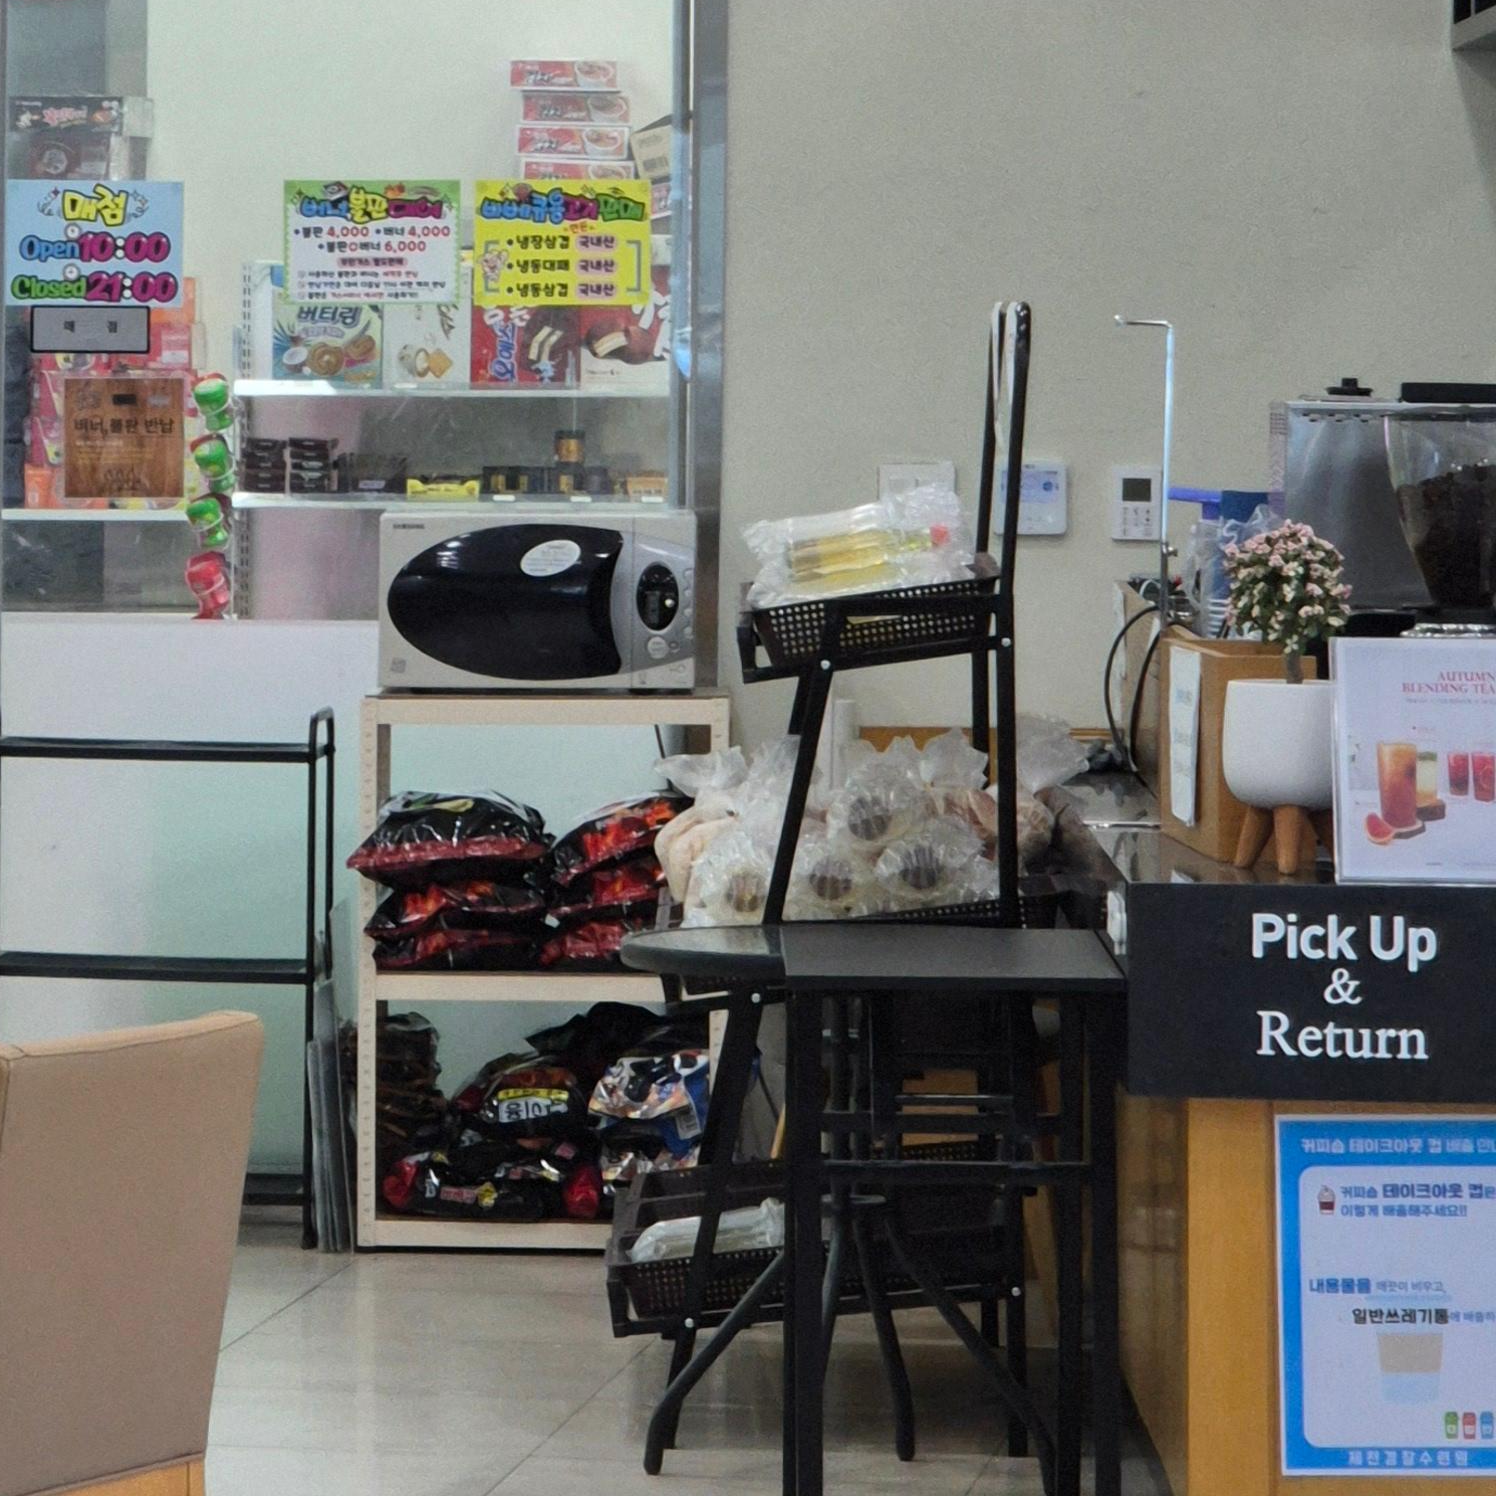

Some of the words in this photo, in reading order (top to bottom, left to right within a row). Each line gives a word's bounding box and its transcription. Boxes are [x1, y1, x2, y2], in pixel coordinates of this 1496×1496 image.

[327, 226, 369, 239] 4,000
[407, 226, 450, 239] 4,000
[19, 235, 80, 262] Open
[78, 231, 171, 262] 10:00
[384, 241, 426, 253] 6,000
[579, 235, 615, 249] 국내산
[516, 259, 570, 273] 냉동대패
[579, 259, 615, 273] 국내산
[11, 274, 86, 300] Closed
[84, 271, 178, 303] 21:00
[516, 283, 568, 297] 냉동삼겹
[579, 283, 615, 297] 국내산
[297, 304, 361, 329] 버터링
[145, 417, 175, 434] 반납
[1402, 682, 1468, 695] BLENDING
[1252, 913, 1358, 960] Pick
[1370, 915, 1438, 973] Up
[1323, 968, 1363, 1005] &
[1256, 1010, 1429, 1060] Return
[1349, 1138, 1422, 1154] 테이크아웃
[1340, 1185, 1378, 1199] 커피숍
[1382, 1183, 1464, 1199] 테이크아웃
[1309, 1278, 1371, 1294] 내용물을
